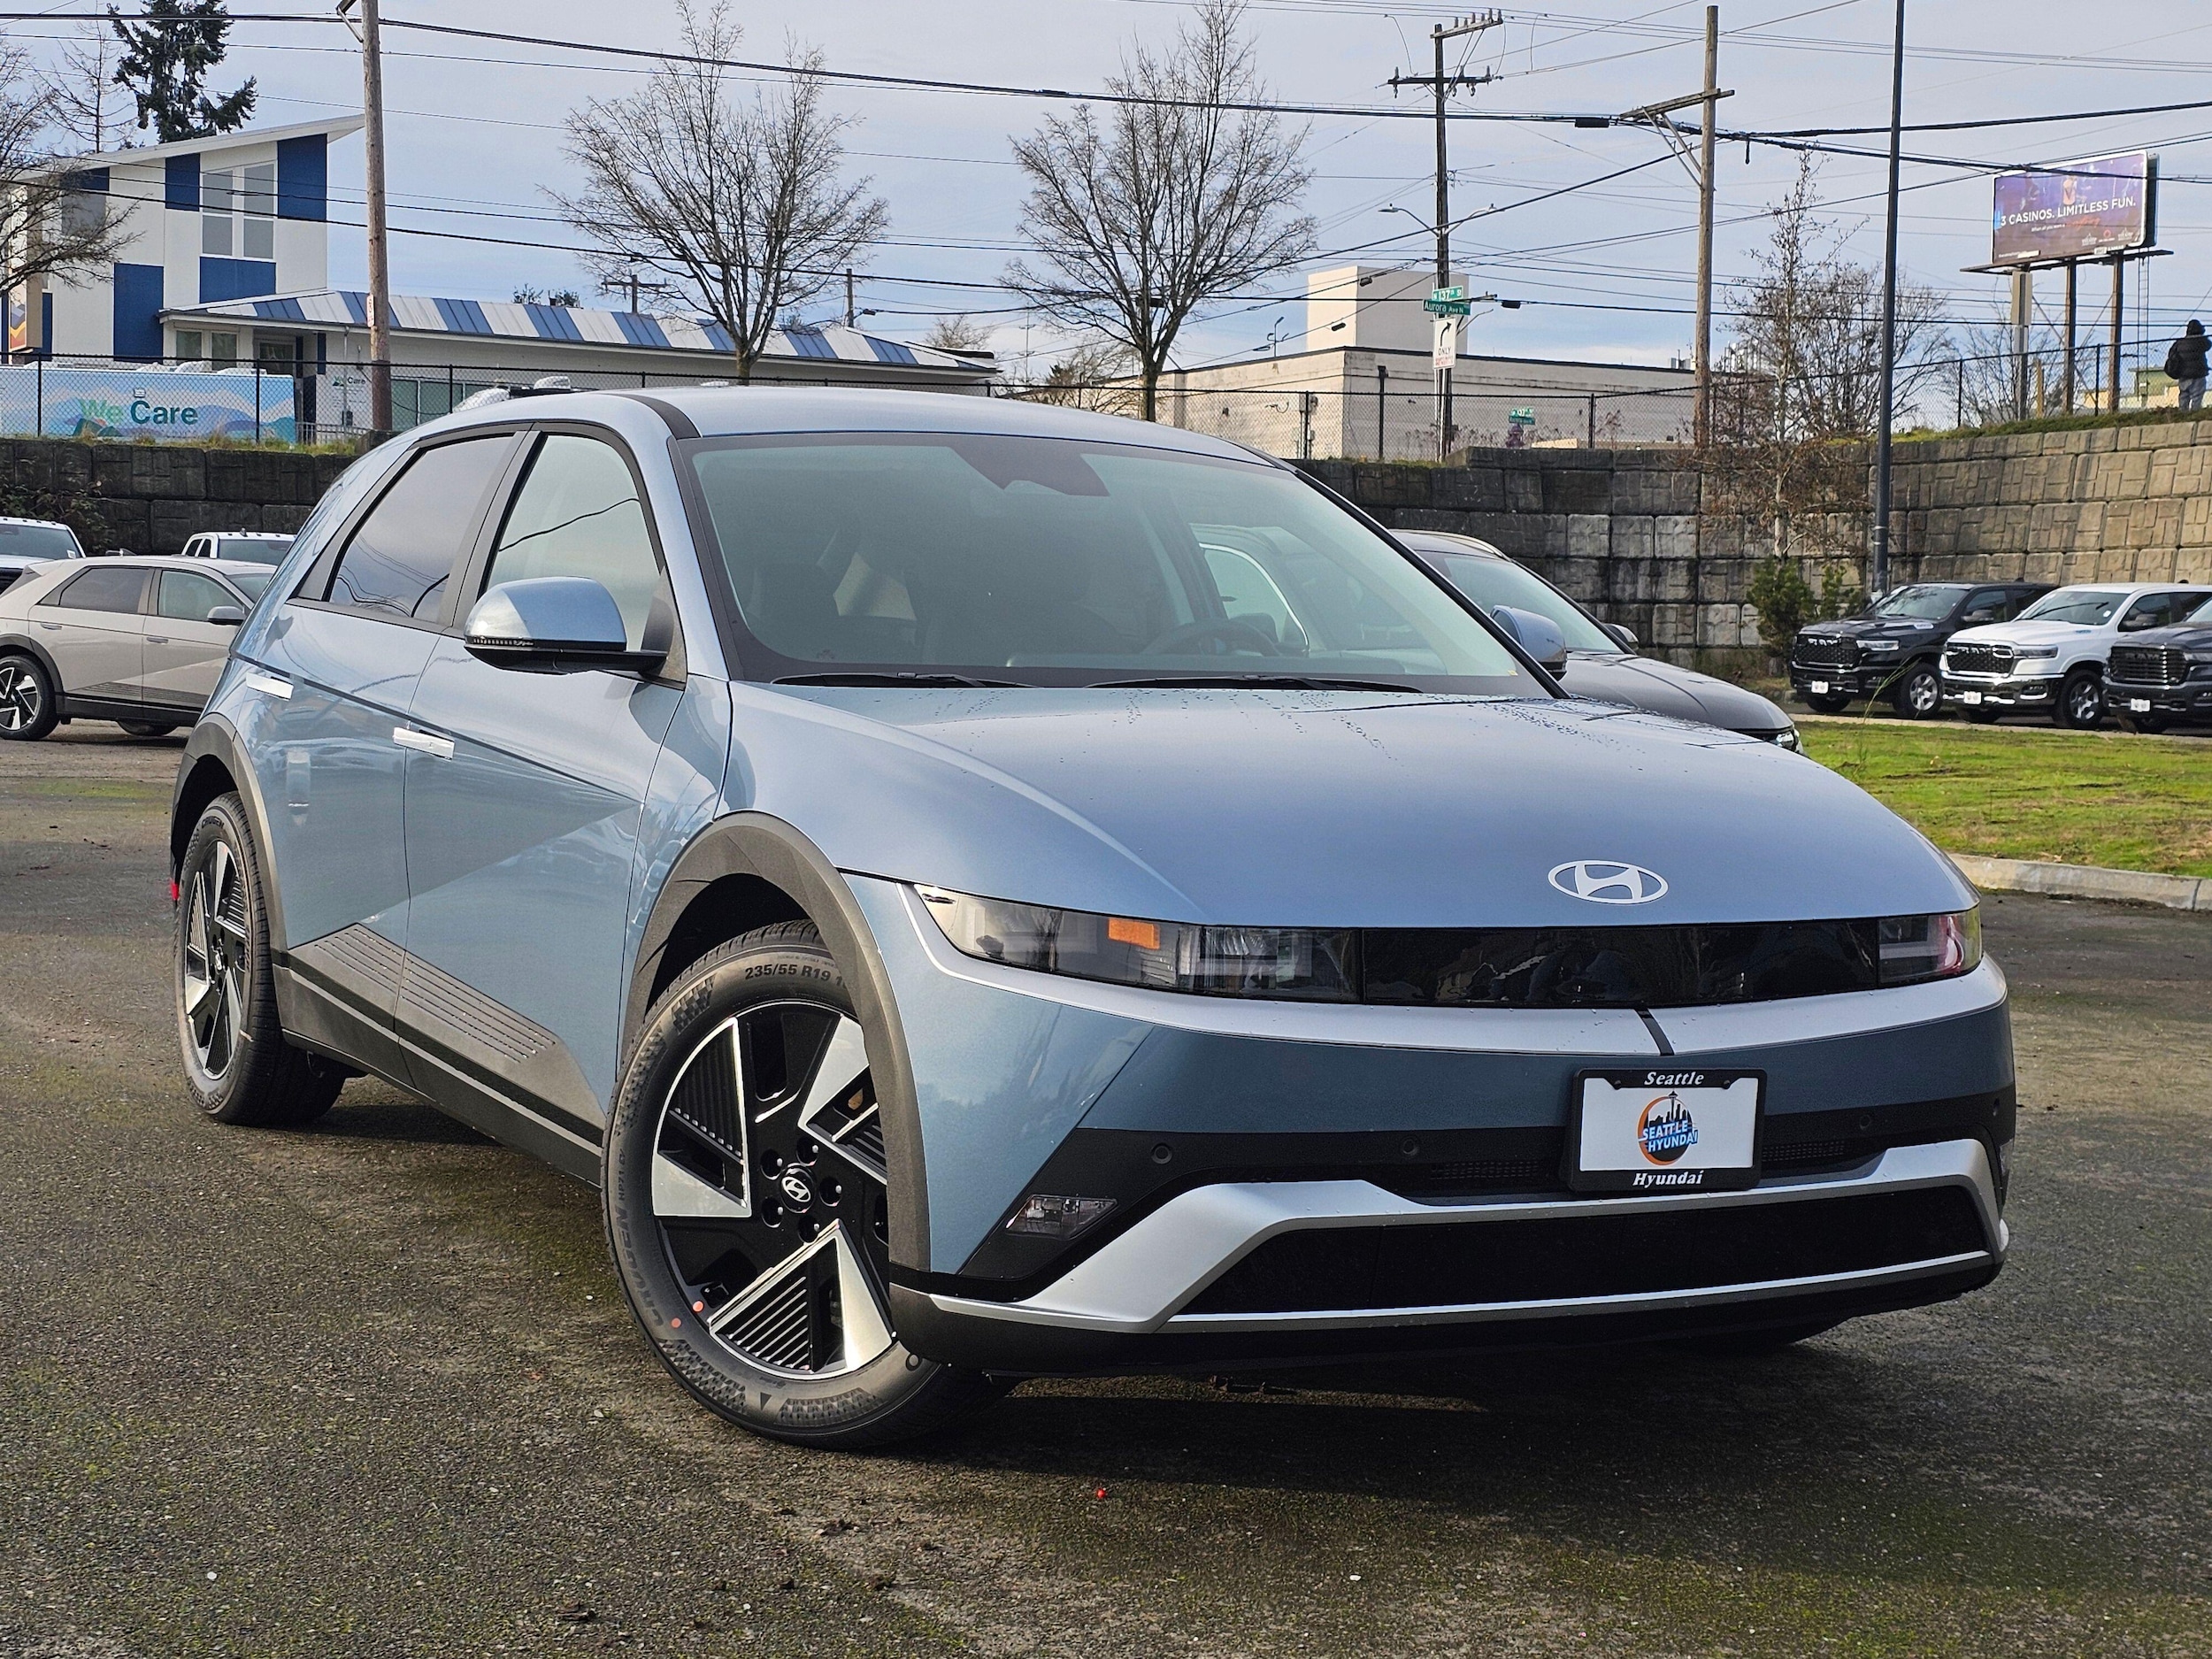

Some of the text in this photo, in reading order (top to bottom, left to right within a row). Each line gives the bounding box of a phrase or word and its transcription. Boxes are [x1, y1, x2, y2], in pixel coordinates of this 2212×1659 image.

[2001, 215, 2007, 227] 3
[2008, 209, 2055, 226] CASINOS.
[2057, 201, 2108, 218] LIMITLESS
[2111, 196, 2136, 210] FUN.
[1424, 301, 1447, 312] Aurora
[1438, 347, 1452, 356] ONLY
[130, 400, 199, 425] Care
[745, 964, 797, 980] 235/55
[801, 965, 832, 981] R19
[1644, 1071, 1705, 1086] Seattle
[1642, 1119, 1688, 1141] SEATTLE
[1647, 1128, 1699, 1153] HYUNDAI
[1632, 1170, 1705, 1188] Hyundai
